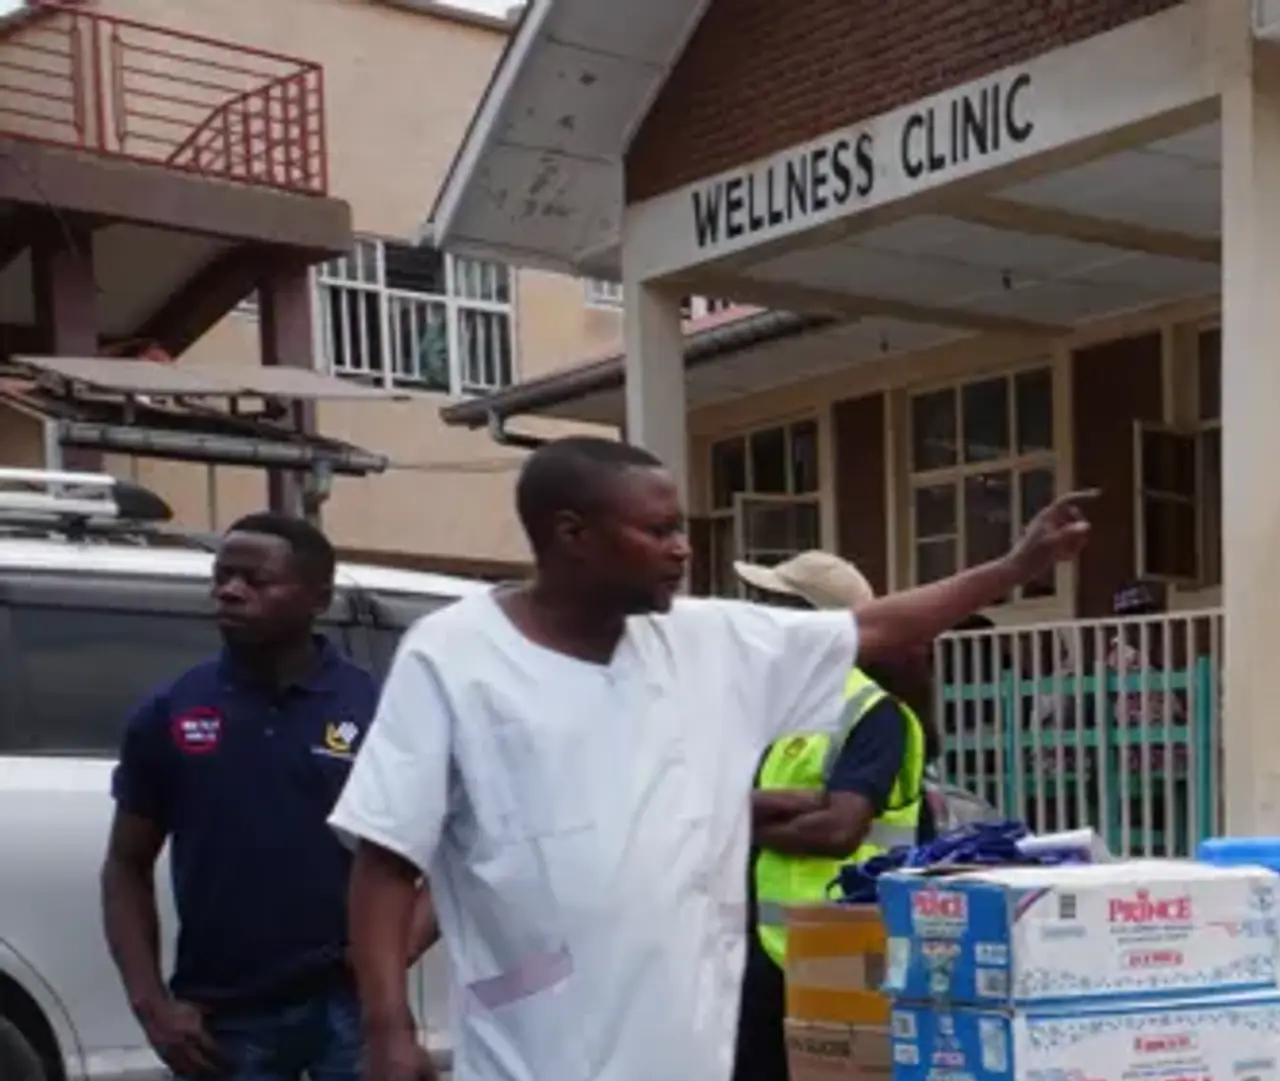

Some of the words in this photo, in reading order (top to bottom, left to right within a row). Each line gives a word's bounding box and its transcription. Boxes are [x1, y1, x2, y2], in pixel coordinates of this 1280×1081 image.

[691, 132, 874, 248] WELLNESS
[901, 73, 1034, 178] CLINIC
[1107, 889, 1192, 923] PRINCE
